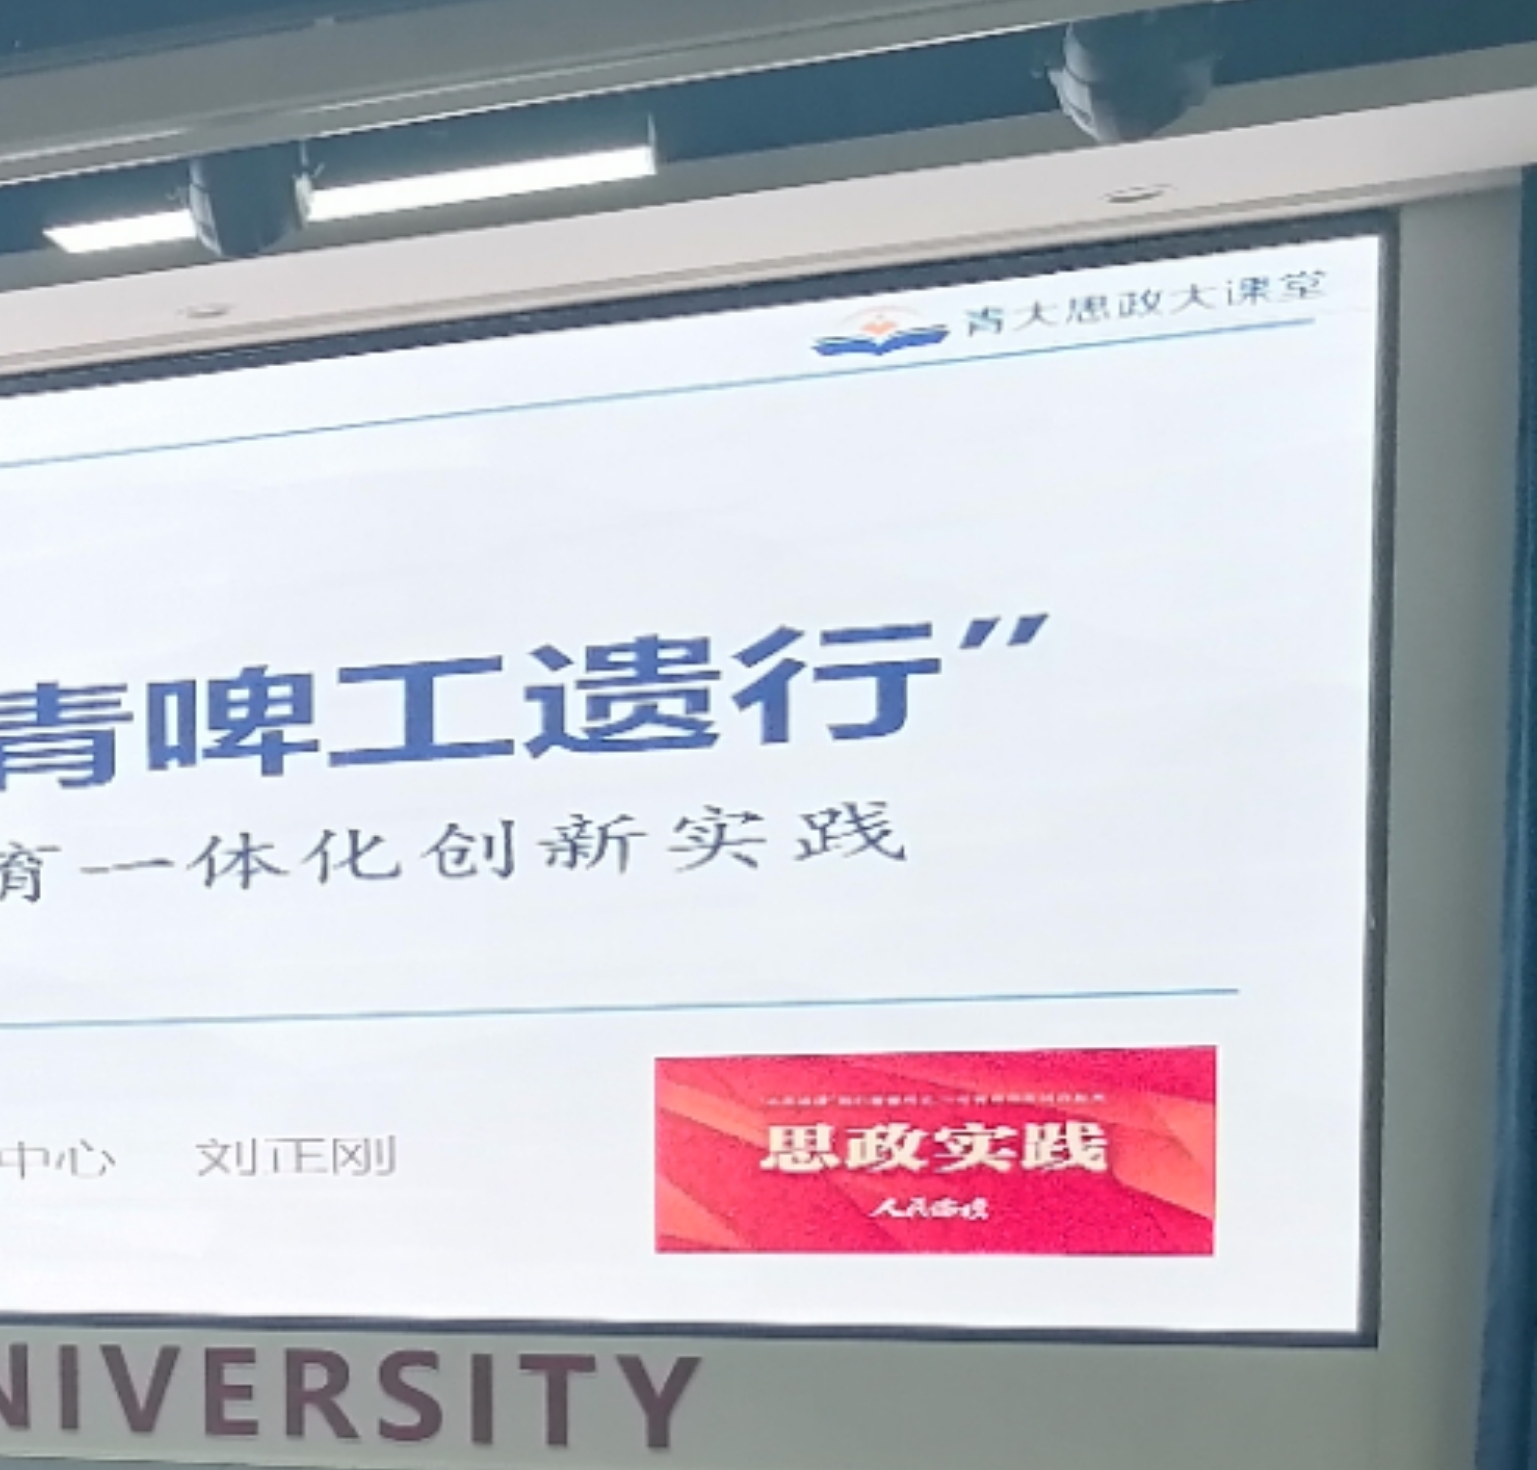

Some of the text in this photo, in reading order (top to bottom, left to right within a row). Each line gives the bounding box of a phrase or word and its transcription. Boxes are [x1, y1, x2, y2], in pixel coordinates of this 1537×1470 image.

[195, 1135, 396, 1177] 刘正刚
[759, 1120, 1109, 1174] 思政实践
